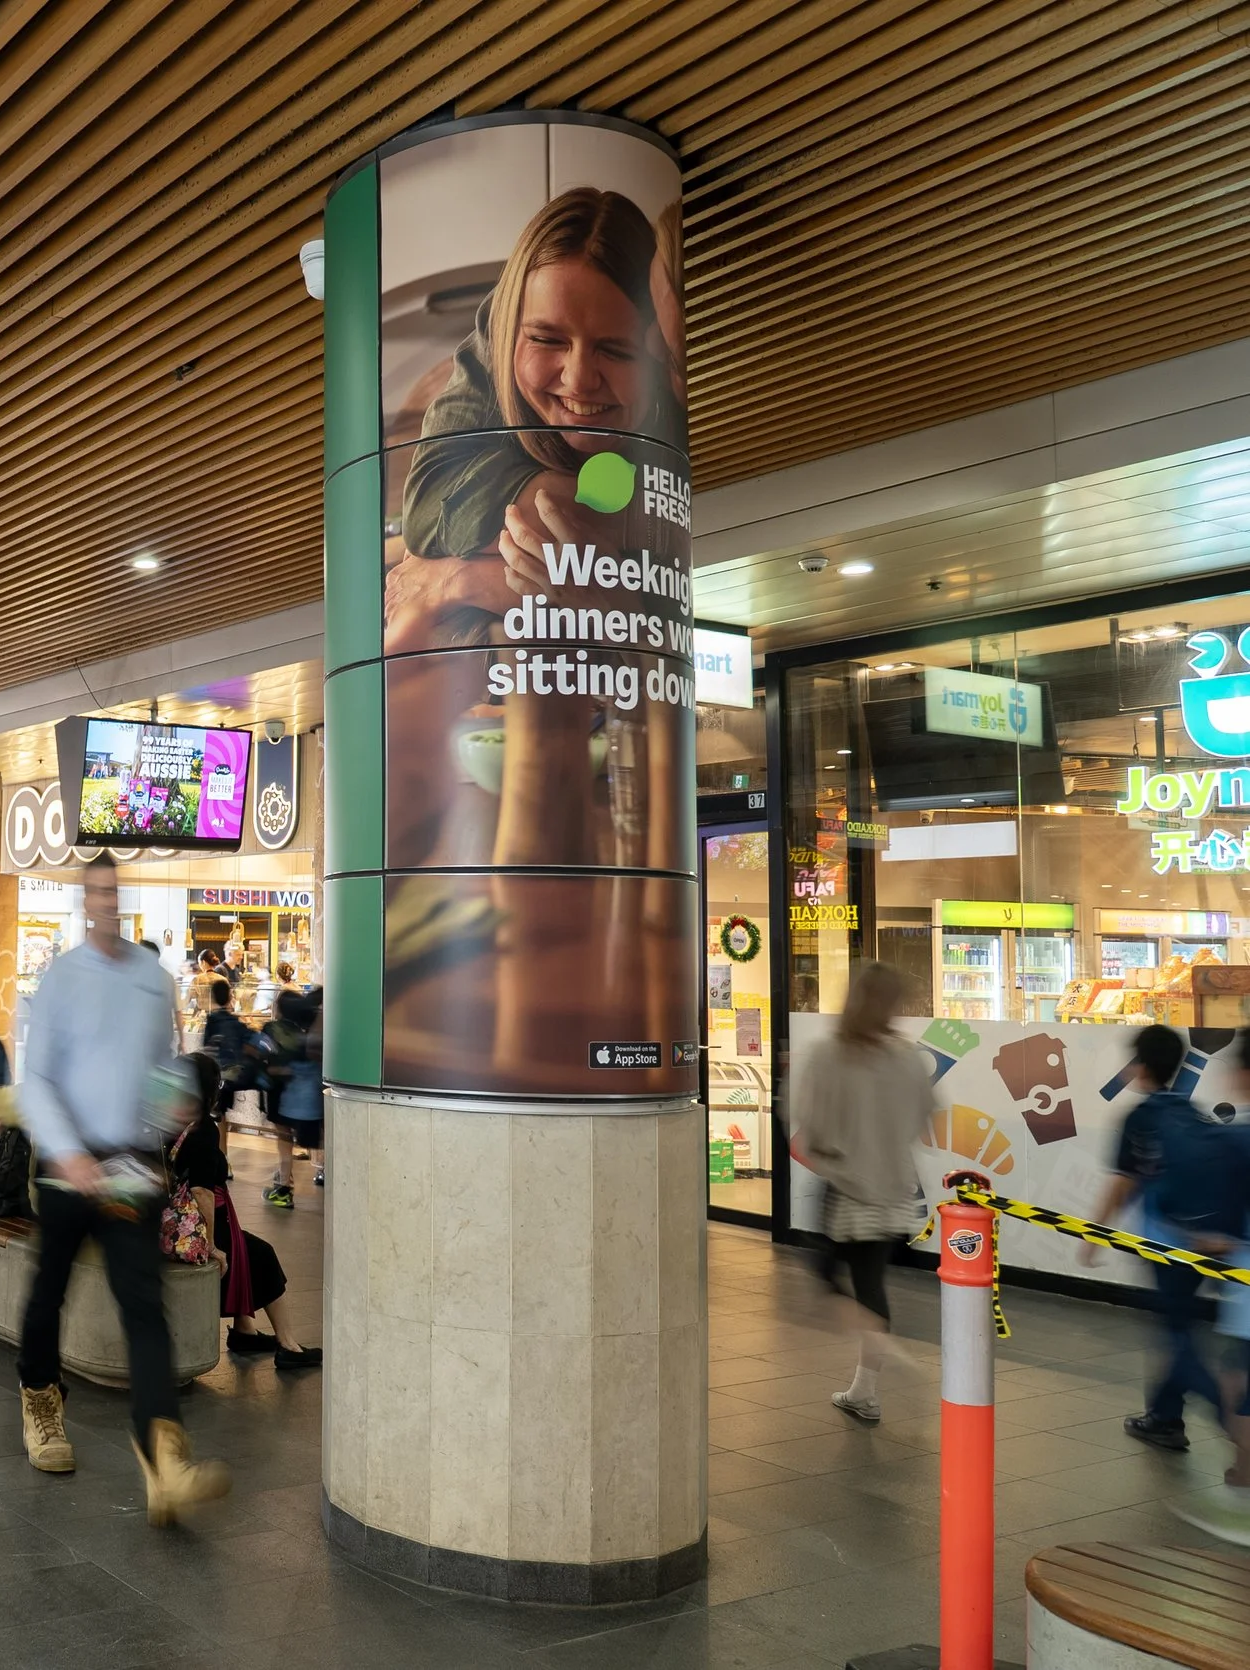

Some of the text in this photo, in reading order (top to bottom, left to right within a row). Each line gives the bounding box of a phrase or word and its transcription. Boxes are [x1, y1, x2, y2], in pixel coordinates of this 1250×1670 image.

[643, 463, 692, 507] HELLO
[643, 491, 692, 533] FRESH
[503, 594, 663, 648] dinners
[487, 650, 638, 710] sitting
[155, 737, 181, 746] YEARS
[141, 754, 193, 765] DELICIOUSLY
[139, 763, 191, 779] AUSSIE
[210, 785, 231, 793] BETTER
[750, 794, 763, 807] 37
[1151, 828, 1250, 875] 开心
[202, 888, 270, 906] SUSHI
[615, 1053, 657, 1066] App Store
